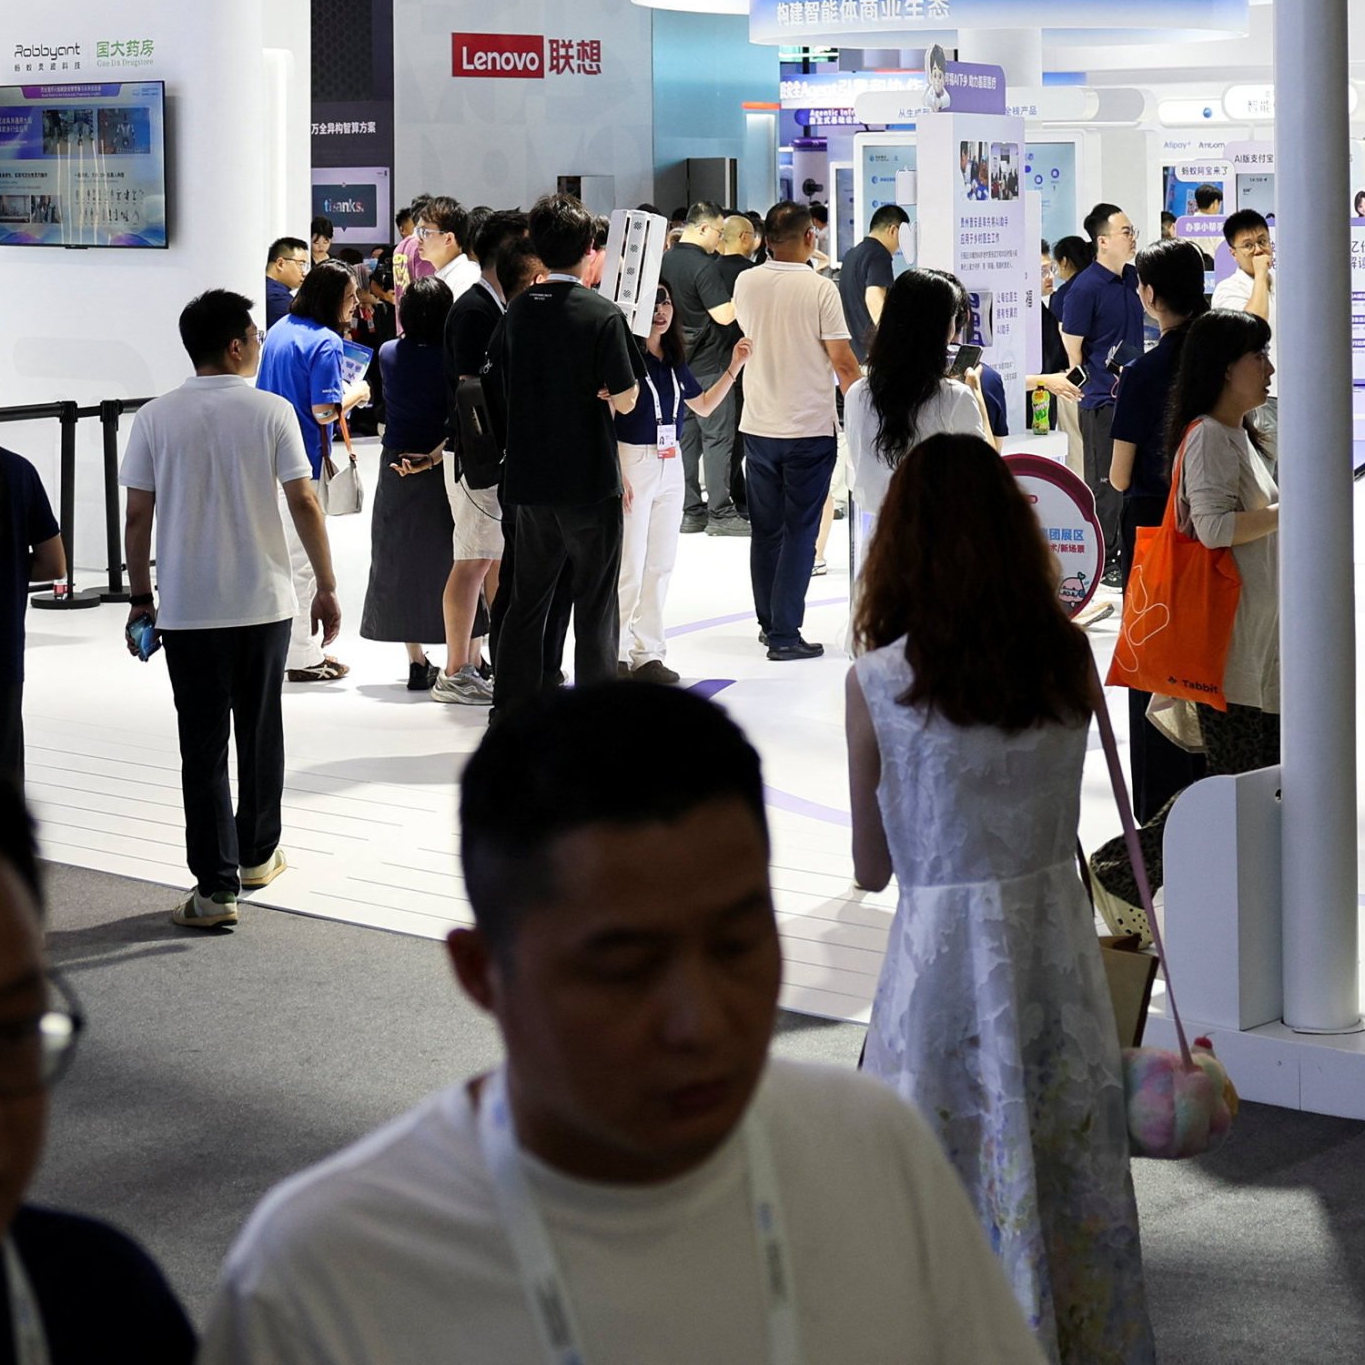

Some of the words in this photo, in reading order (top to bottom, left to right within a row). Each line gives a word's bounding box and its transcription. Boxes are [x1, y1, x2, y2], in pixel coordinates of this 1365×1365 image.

[14, 43, 80, 60] Robbyant
[96, 39, 154, 58] 国大药房
[548, 39, 602, 75] 联想
[461, 46, 540, 71] Lenovo
[1043, 527, 1084, 541] 团展区
[1182, 679, 1219, 694] Tabbit
